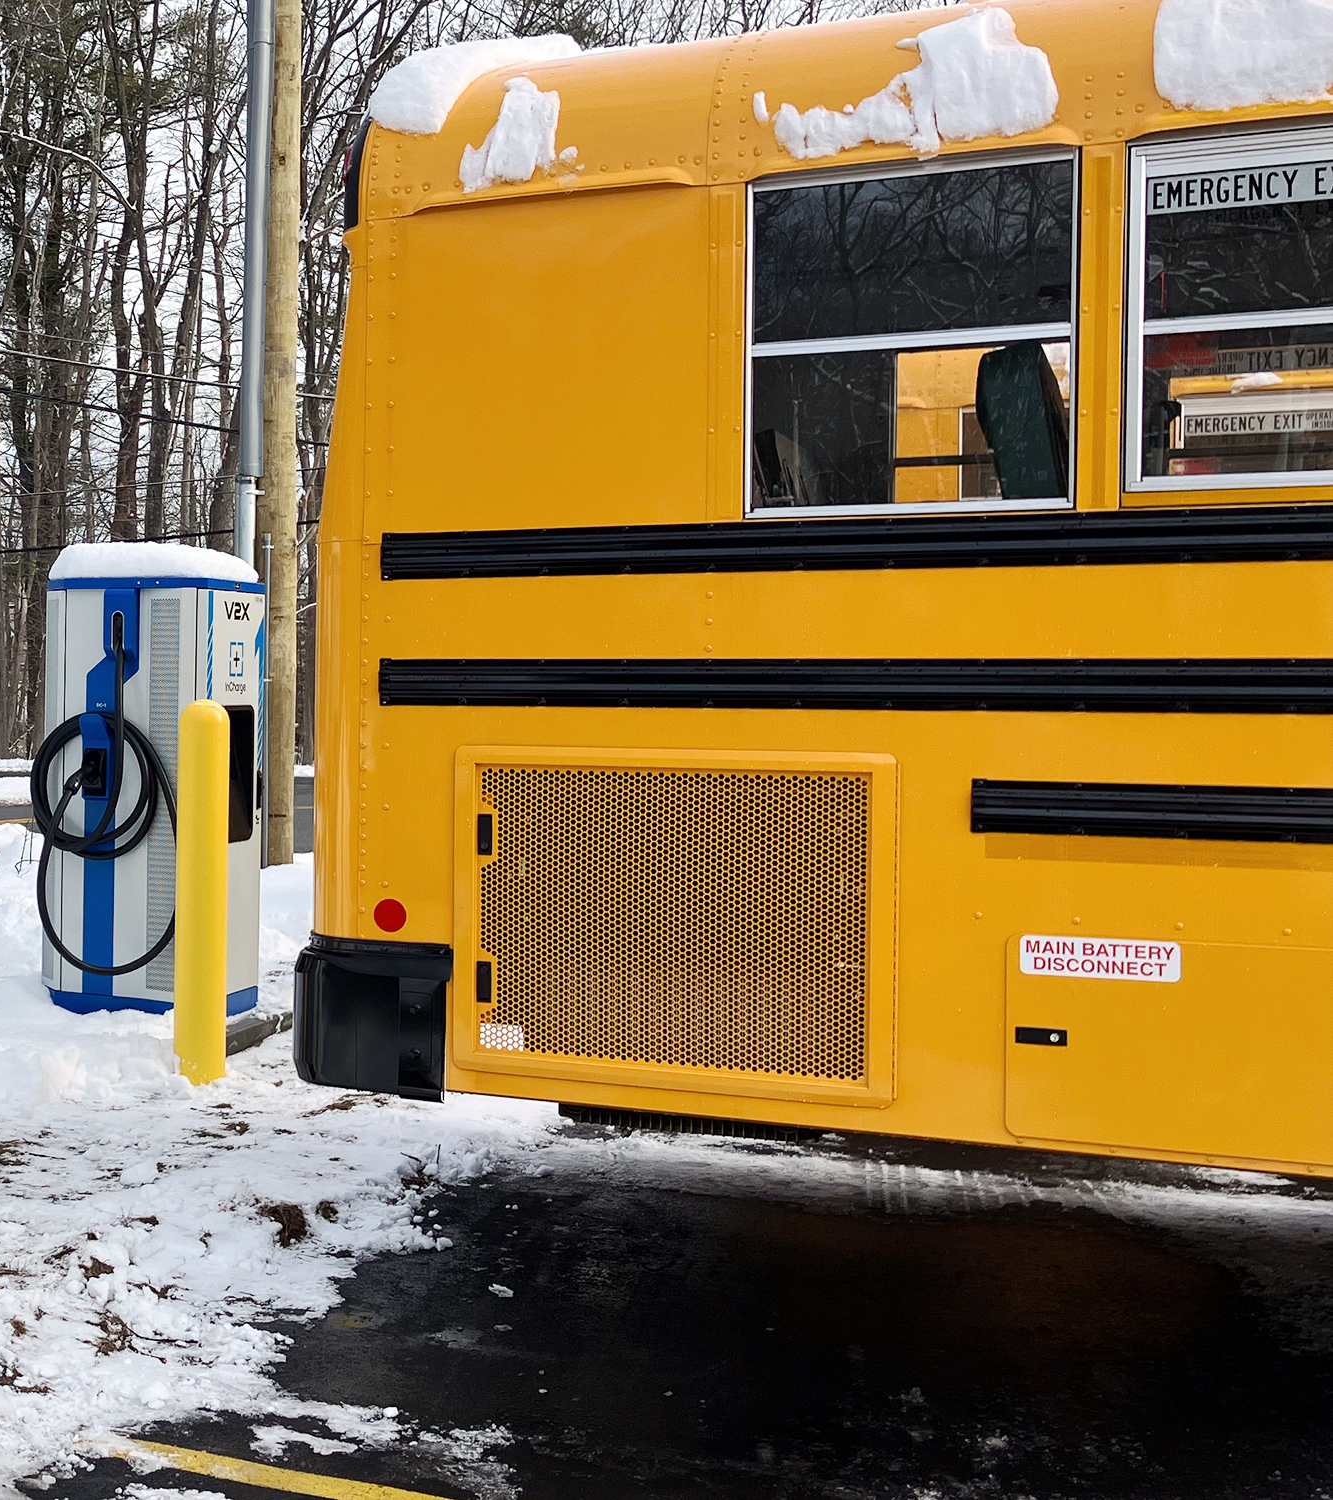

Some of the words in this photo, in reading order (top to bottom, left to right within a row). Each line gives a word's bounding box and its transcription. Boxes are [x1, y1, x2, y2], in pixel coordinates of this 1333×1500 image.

[1152, 169, 1299, 209] EMERGENCY
[1315, 166, 1333, 196] E
[1186, 415, 1265, 433] EMERGENCY
[1274, 413, 1303, 430] EXIT
[224, 600, 250, 621] V2X
[225, 681, 246, 694] InCharge
[1025, 940, 1075, 955] MAIN
[1082, 943, 1175, 960] BATTERY
[1033, 957, 1167, 977] DISCONNECT
